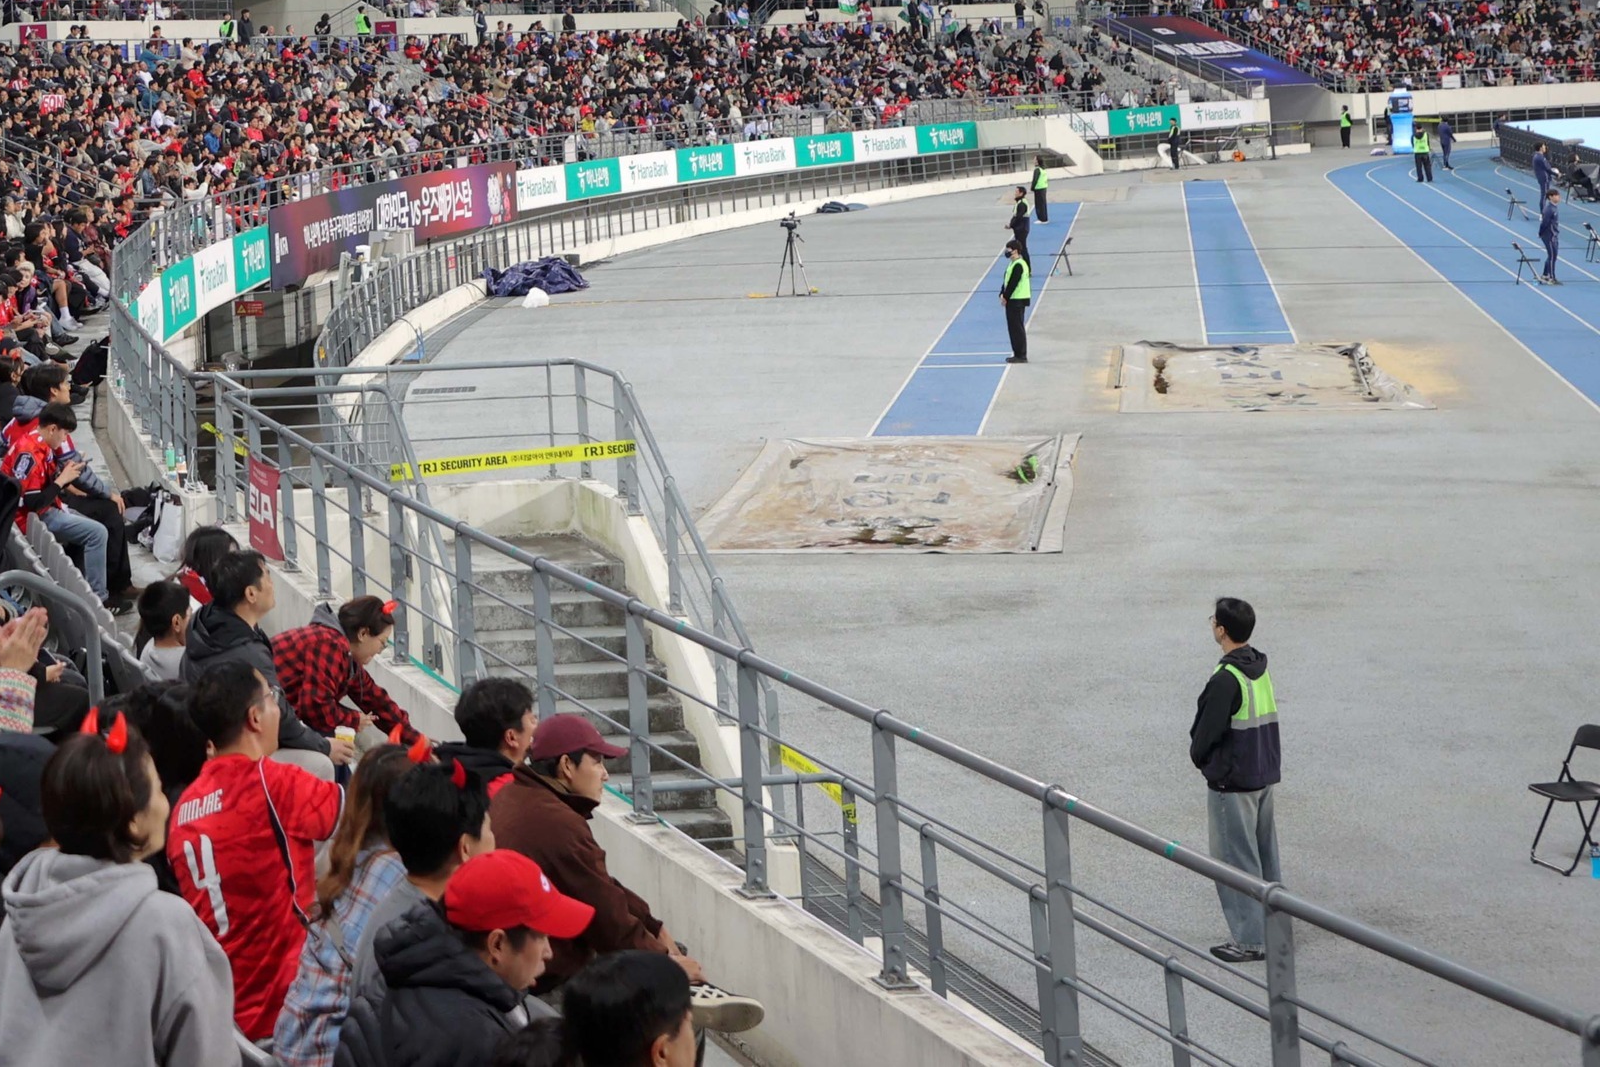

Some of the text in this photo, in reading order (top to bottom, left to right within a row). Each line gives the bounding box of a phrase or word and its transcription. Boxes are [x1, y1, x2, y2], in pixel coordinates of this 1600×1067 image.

[376, 191, 409, 231] 대한민국
[421, 178, 472, 227] 우즈베키스탄
[440, 458, 482, 471] SECURITY
[485, 455, 508, 466] AREA
[183, 833, 230, 937] 4
